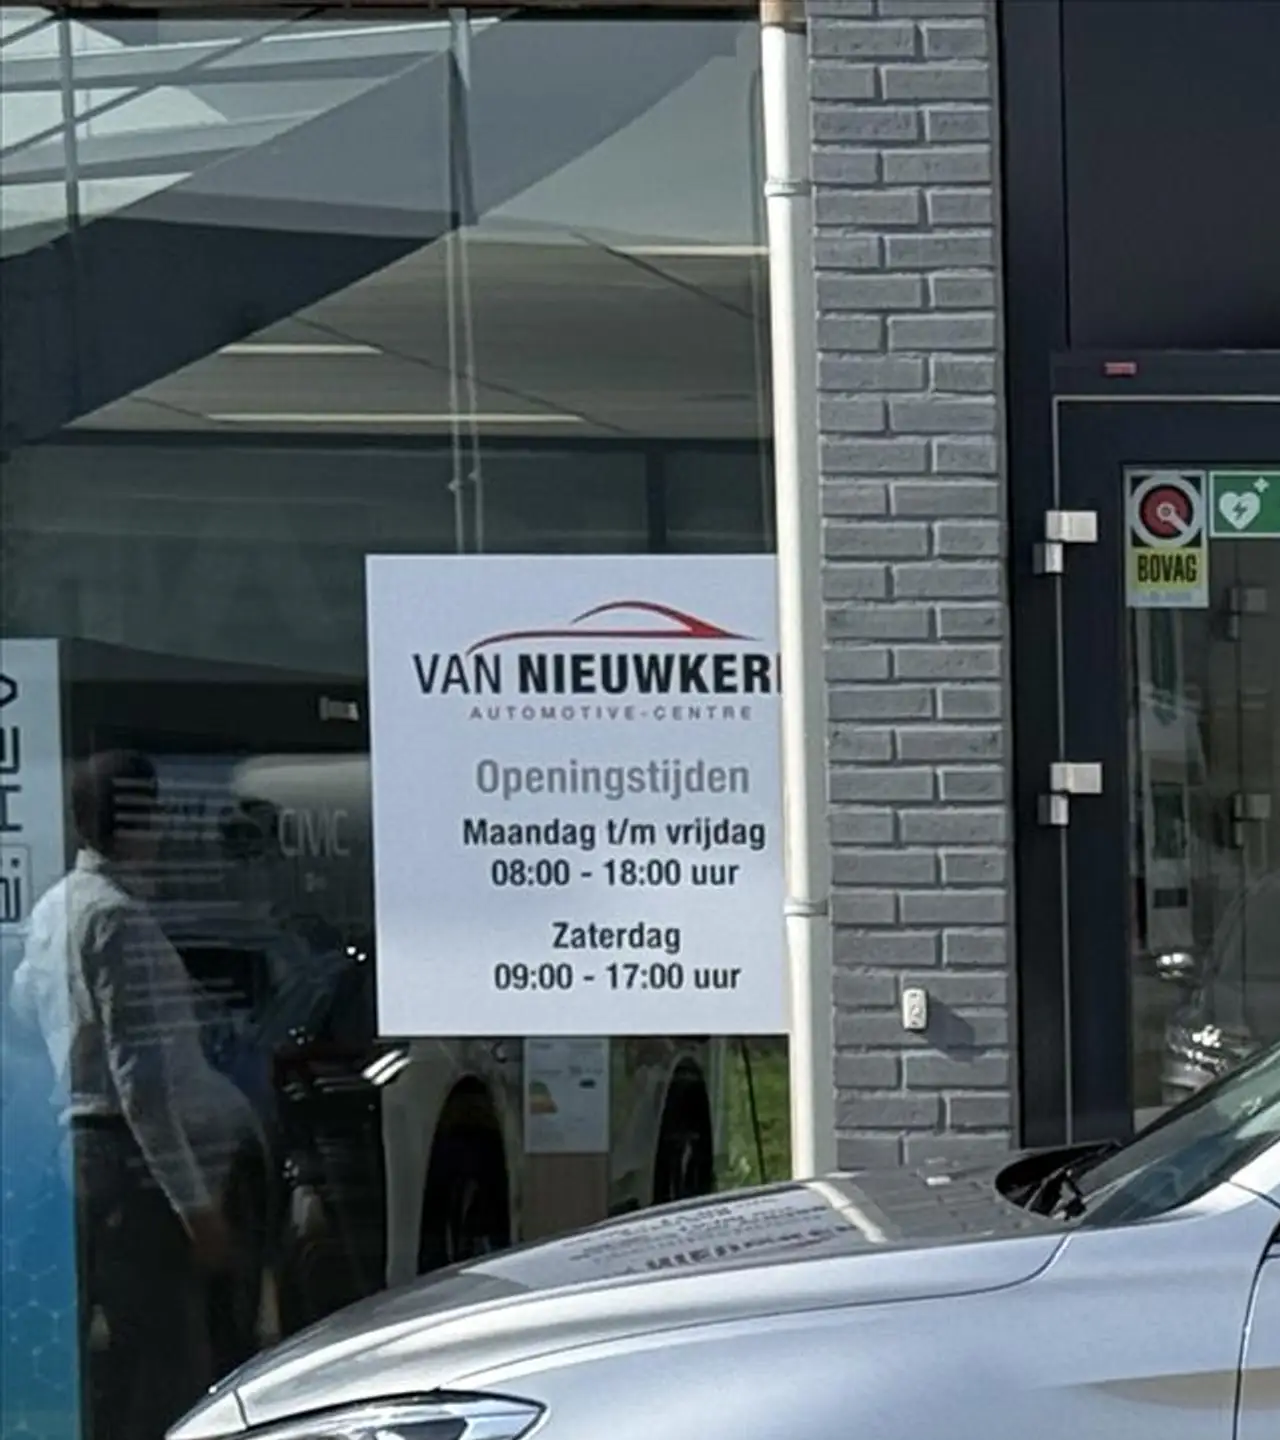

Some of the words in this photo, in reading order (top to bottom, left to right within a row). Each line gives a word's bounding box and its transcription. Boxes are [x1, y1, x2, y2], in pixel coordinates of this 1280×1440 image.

[1137, 554, 1197, 582] BOVAG
[411, 653, 502, 694] VAN
[518, 653, 781, 694] NIEUWKER
[476, 759, 750, 801] Openingstijden
[463, 818, 596, 851] Maandag
[607, 818, 656, 845] t/m
[666, 818, 766, 851] vrijdag
[491, 859, 570, 886] 08:00
[603, 859, 681, 886] 18:00
[691, 864, 740, 886] uur
[552, 921, 681, 954] Zaterdag
[494, 963, 573, 989] 09:00
[605, 963, 683, 989] 17:00
[694, 968, 741, 989] uur
